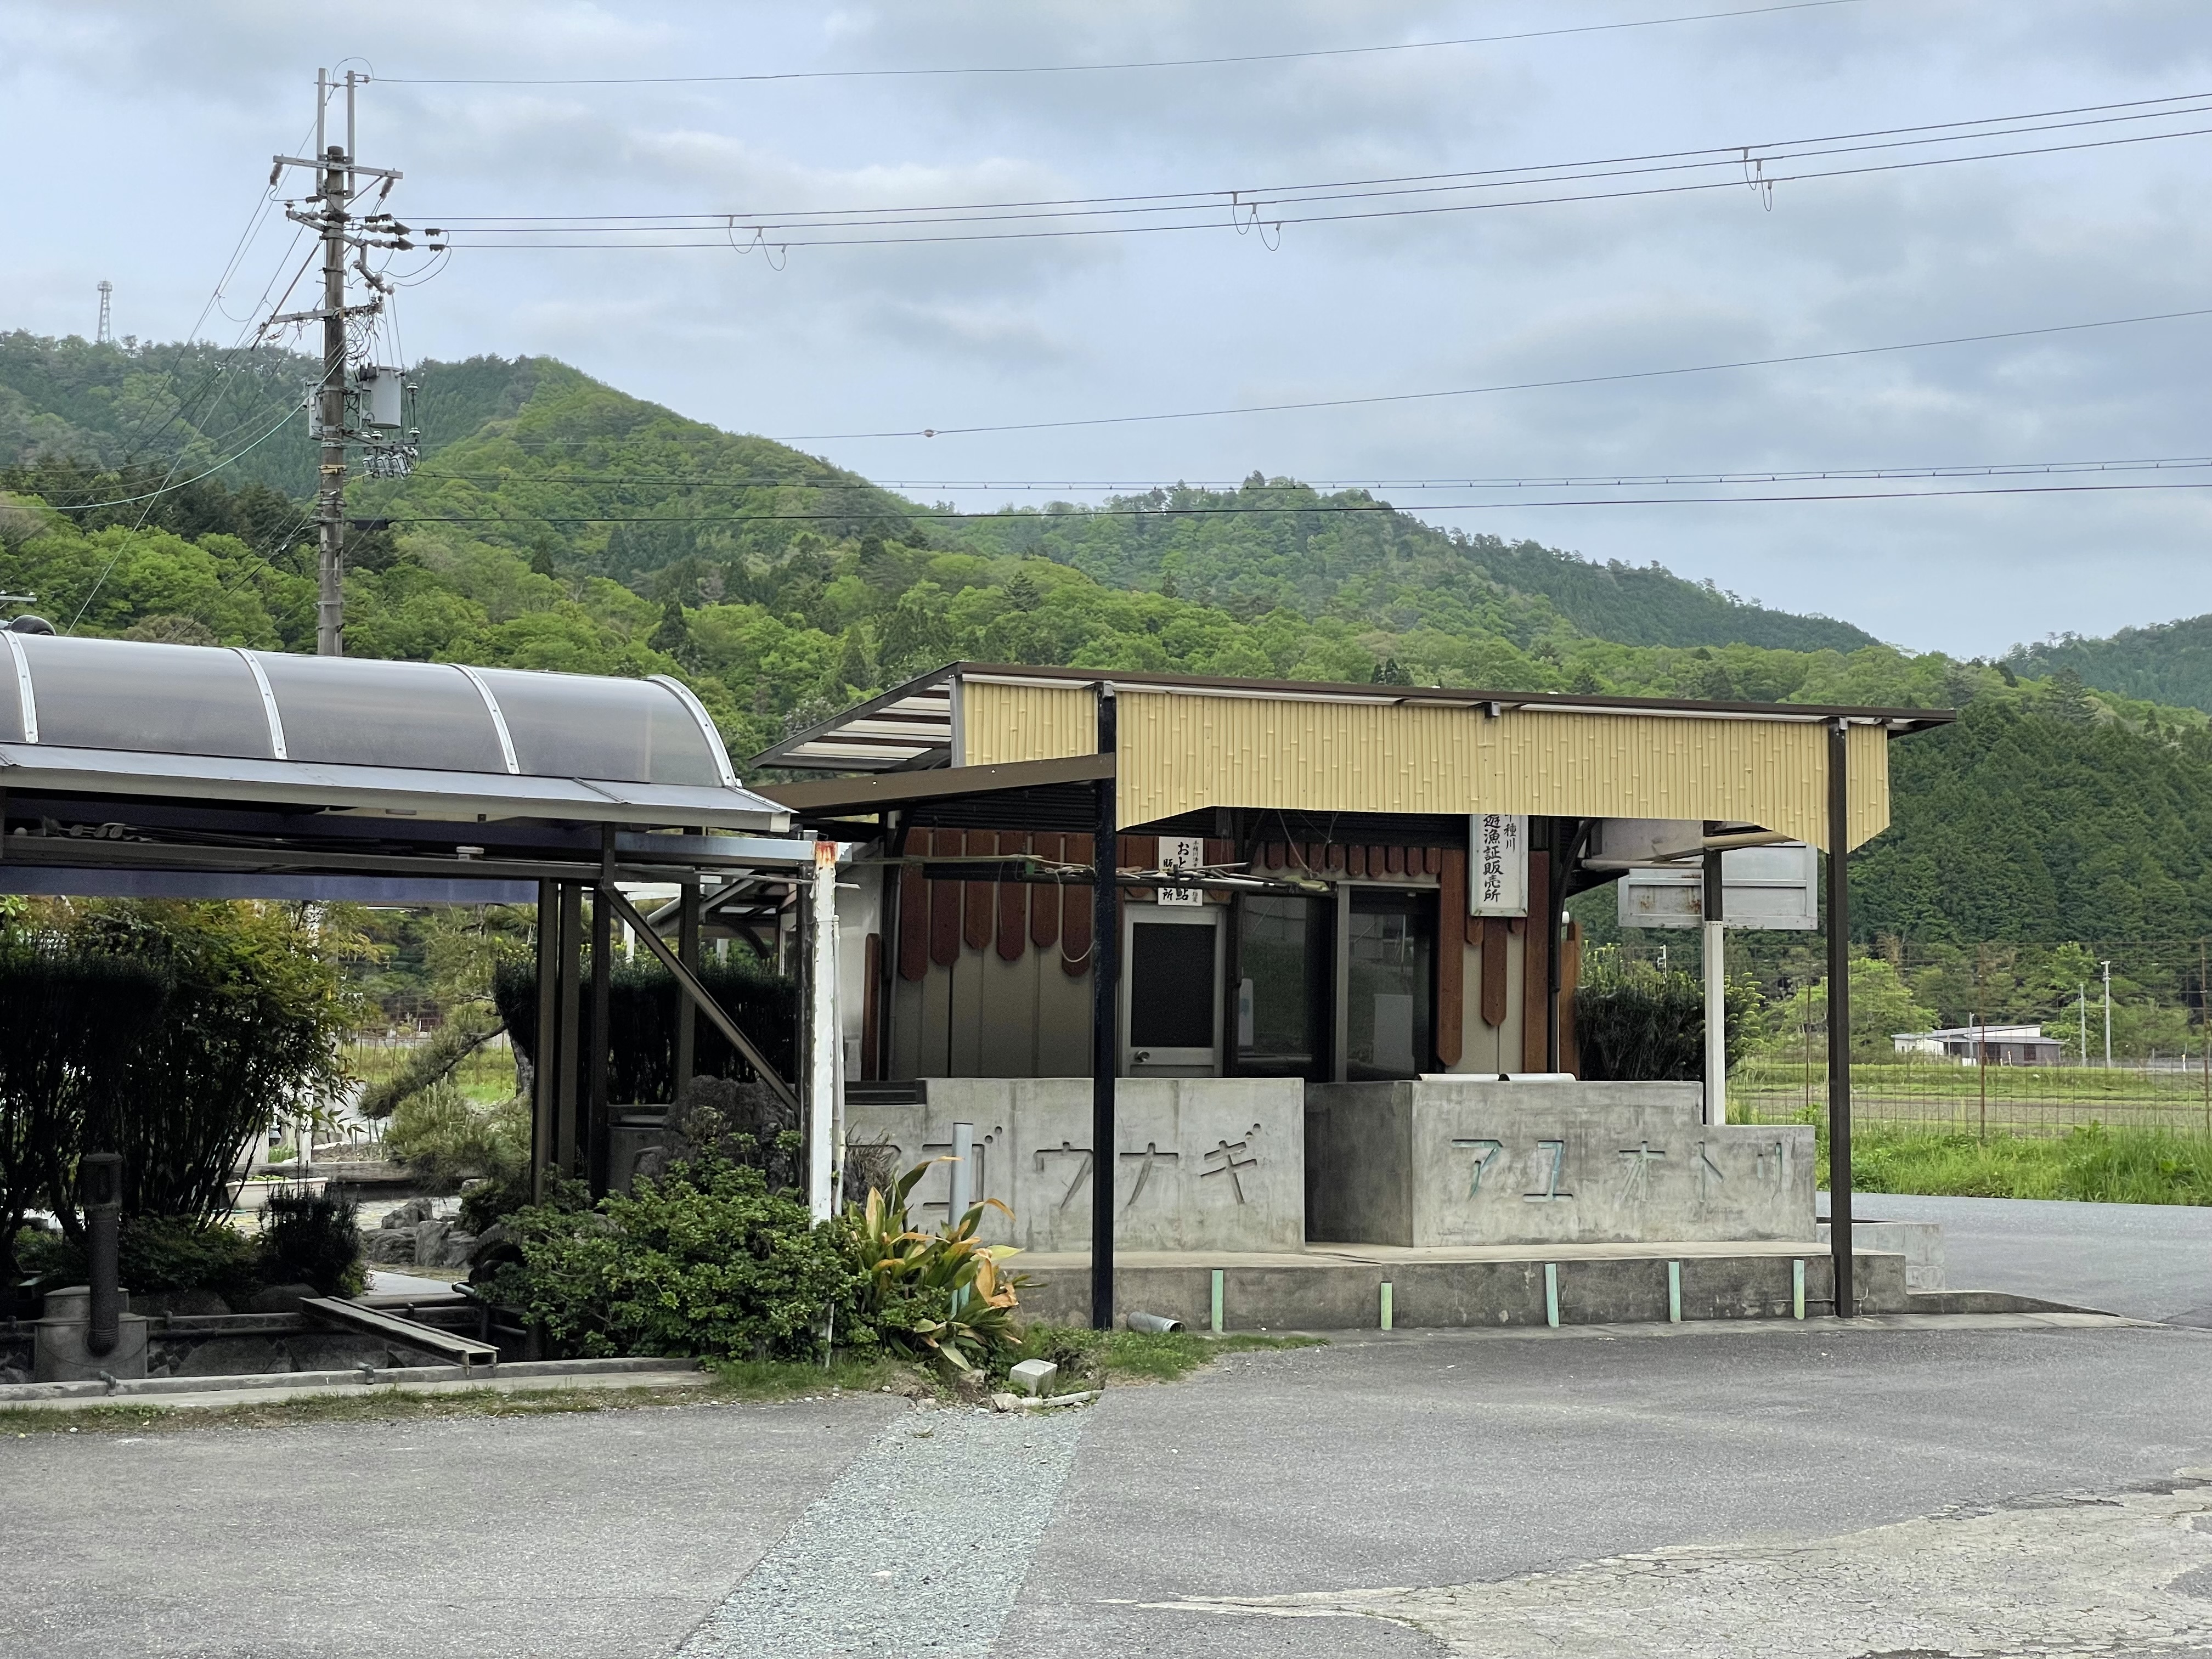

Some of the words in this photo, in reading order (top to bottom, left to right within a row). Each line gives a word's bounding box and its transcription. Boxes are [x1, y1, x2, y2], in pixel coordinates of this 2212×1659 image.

[1163, 859, 1173, 900] 販所
[1483, 814, 1504, 902] 遊漁証販売所
